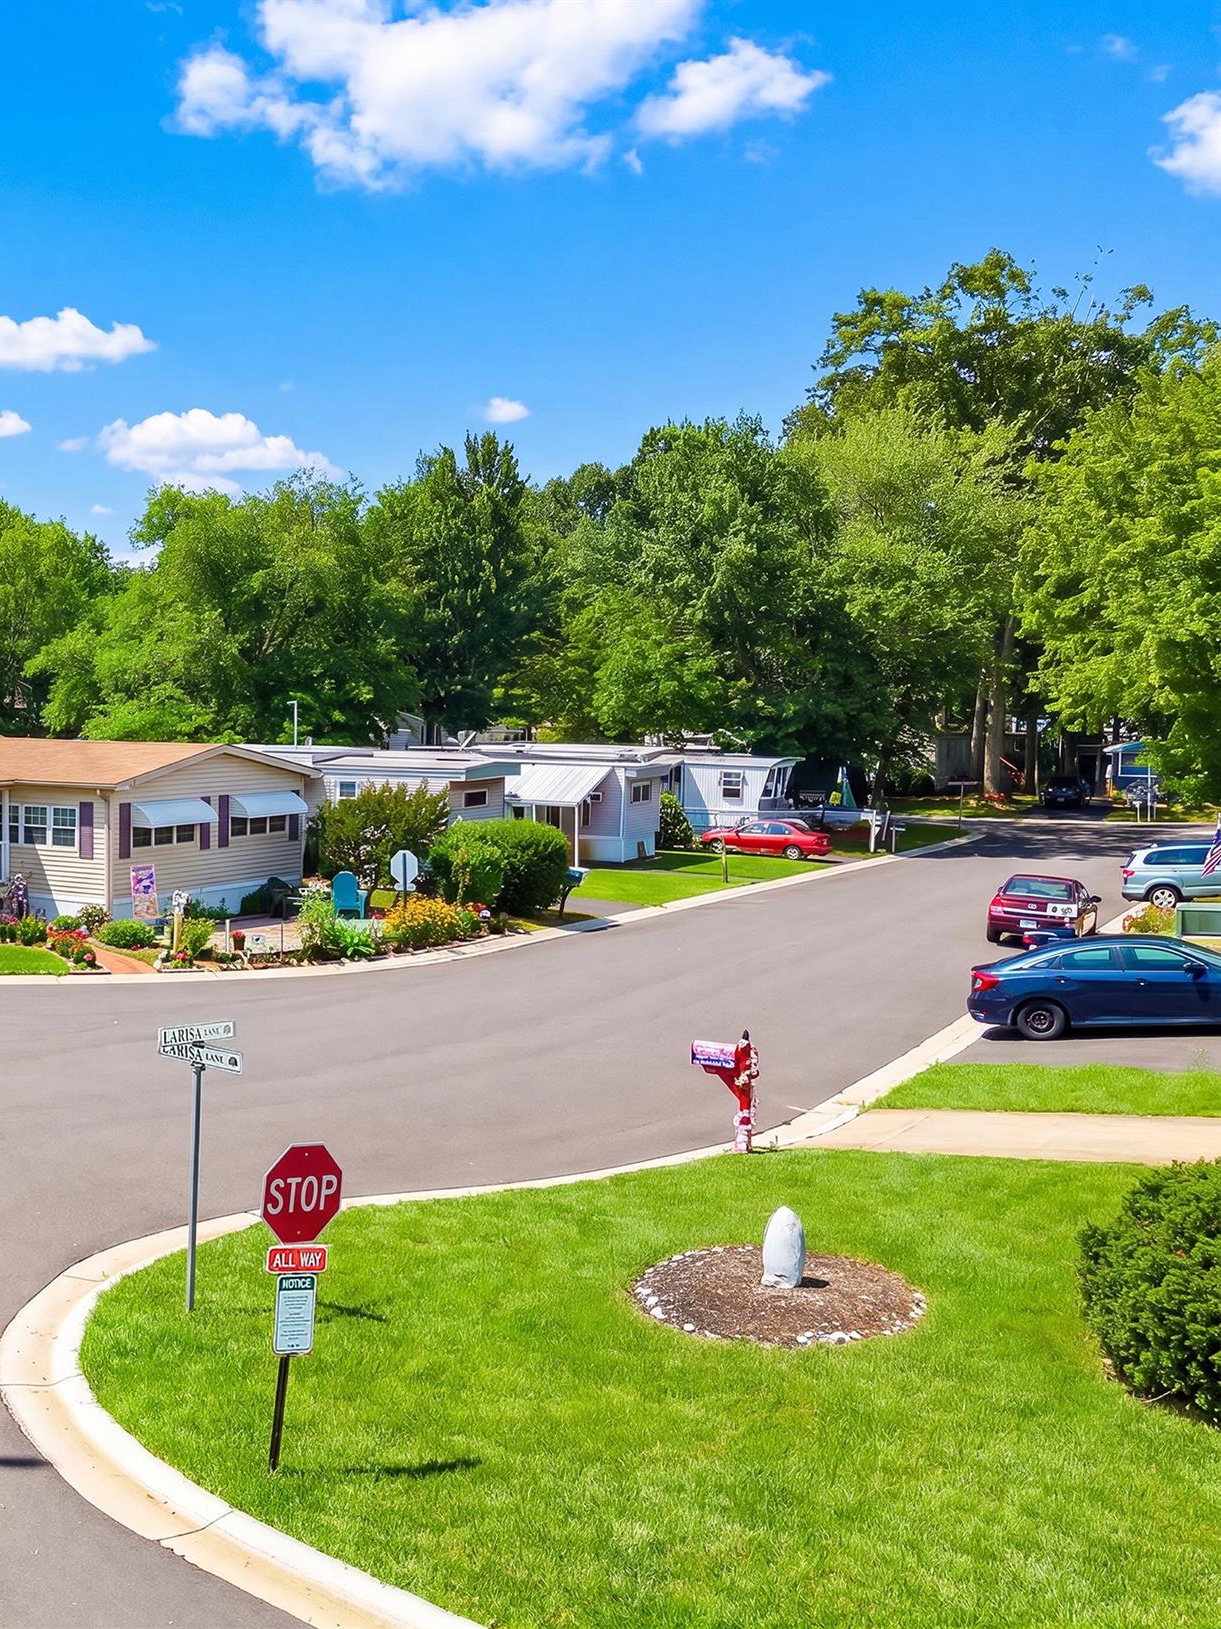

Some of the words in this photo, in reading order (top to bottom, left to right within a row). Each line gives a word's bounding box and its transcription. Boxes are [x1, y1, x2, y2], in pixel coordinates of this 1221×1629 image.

[163, 1027, 202, 1045] LARISA
[203, 1026, 220, 1037] LANE
[205, 1052, 224, 1065] LANE
[266, 1174, 338, 1215] STOP
[273, 1252, 296, 1268] ALL
[300, 1251, 322, 1268] WAY
[282, 1278, 312, 1289] NOTICE
